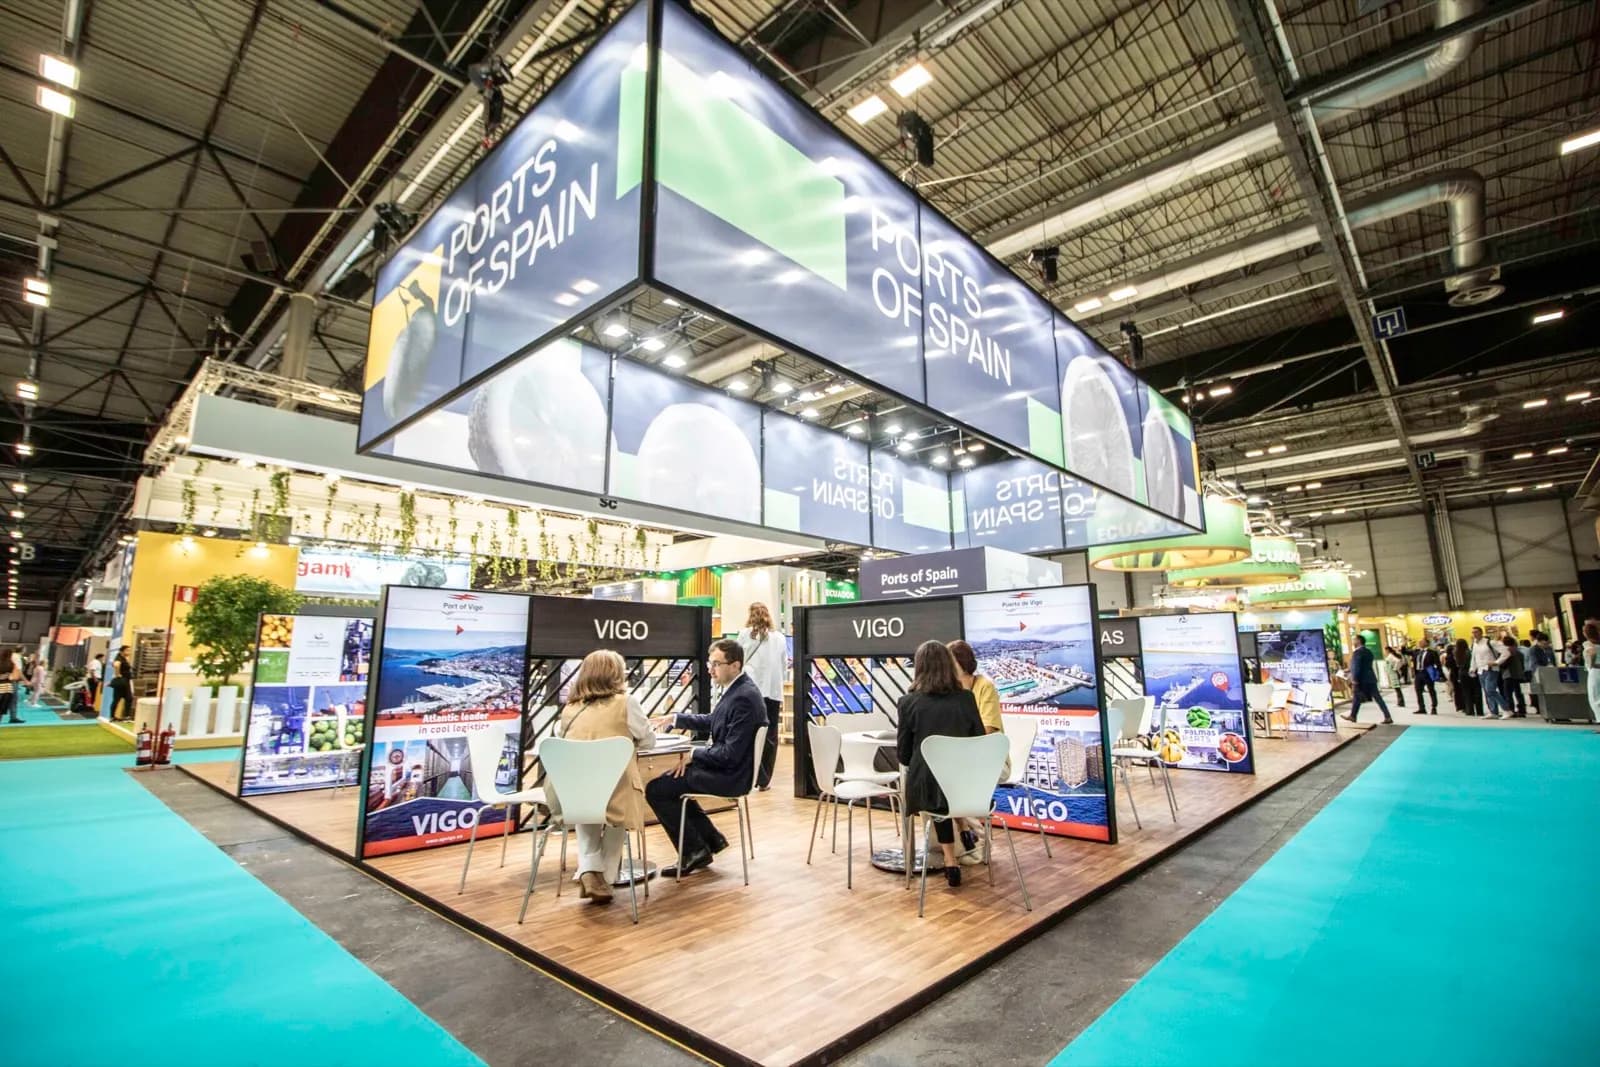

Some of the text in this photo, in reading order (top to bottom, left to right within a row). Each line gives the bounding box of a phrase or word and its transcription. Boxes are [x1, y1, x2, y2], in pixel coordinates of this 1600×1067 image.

[448, 139, 557, 274] PORTS
[444, 162, 599, 327] OF SPAIN
[871, 205, 982, 319] PORTS
[871, 267, 1012, 387] OF SPAIN
[880, 566, 959, 586] Ports of Spain
[443, 602, 459, 610] Port
[1001, 600, 1020, 608] Puerto
[593, 618, 649, 641] VIGO
[852, 617, 905, 639] VIGO
[422, 711, 489, 724] Atlantic leader
[1002, 703, 1059, 714] Líder Atlántico
[419, 726, 428, 735] in
[431, 724, 450, 734] cool
[1040, 718, 1053, 726] del
[1007, 795, 1068, 822] VIGO
[411, 806, 478, 837] VIGO
